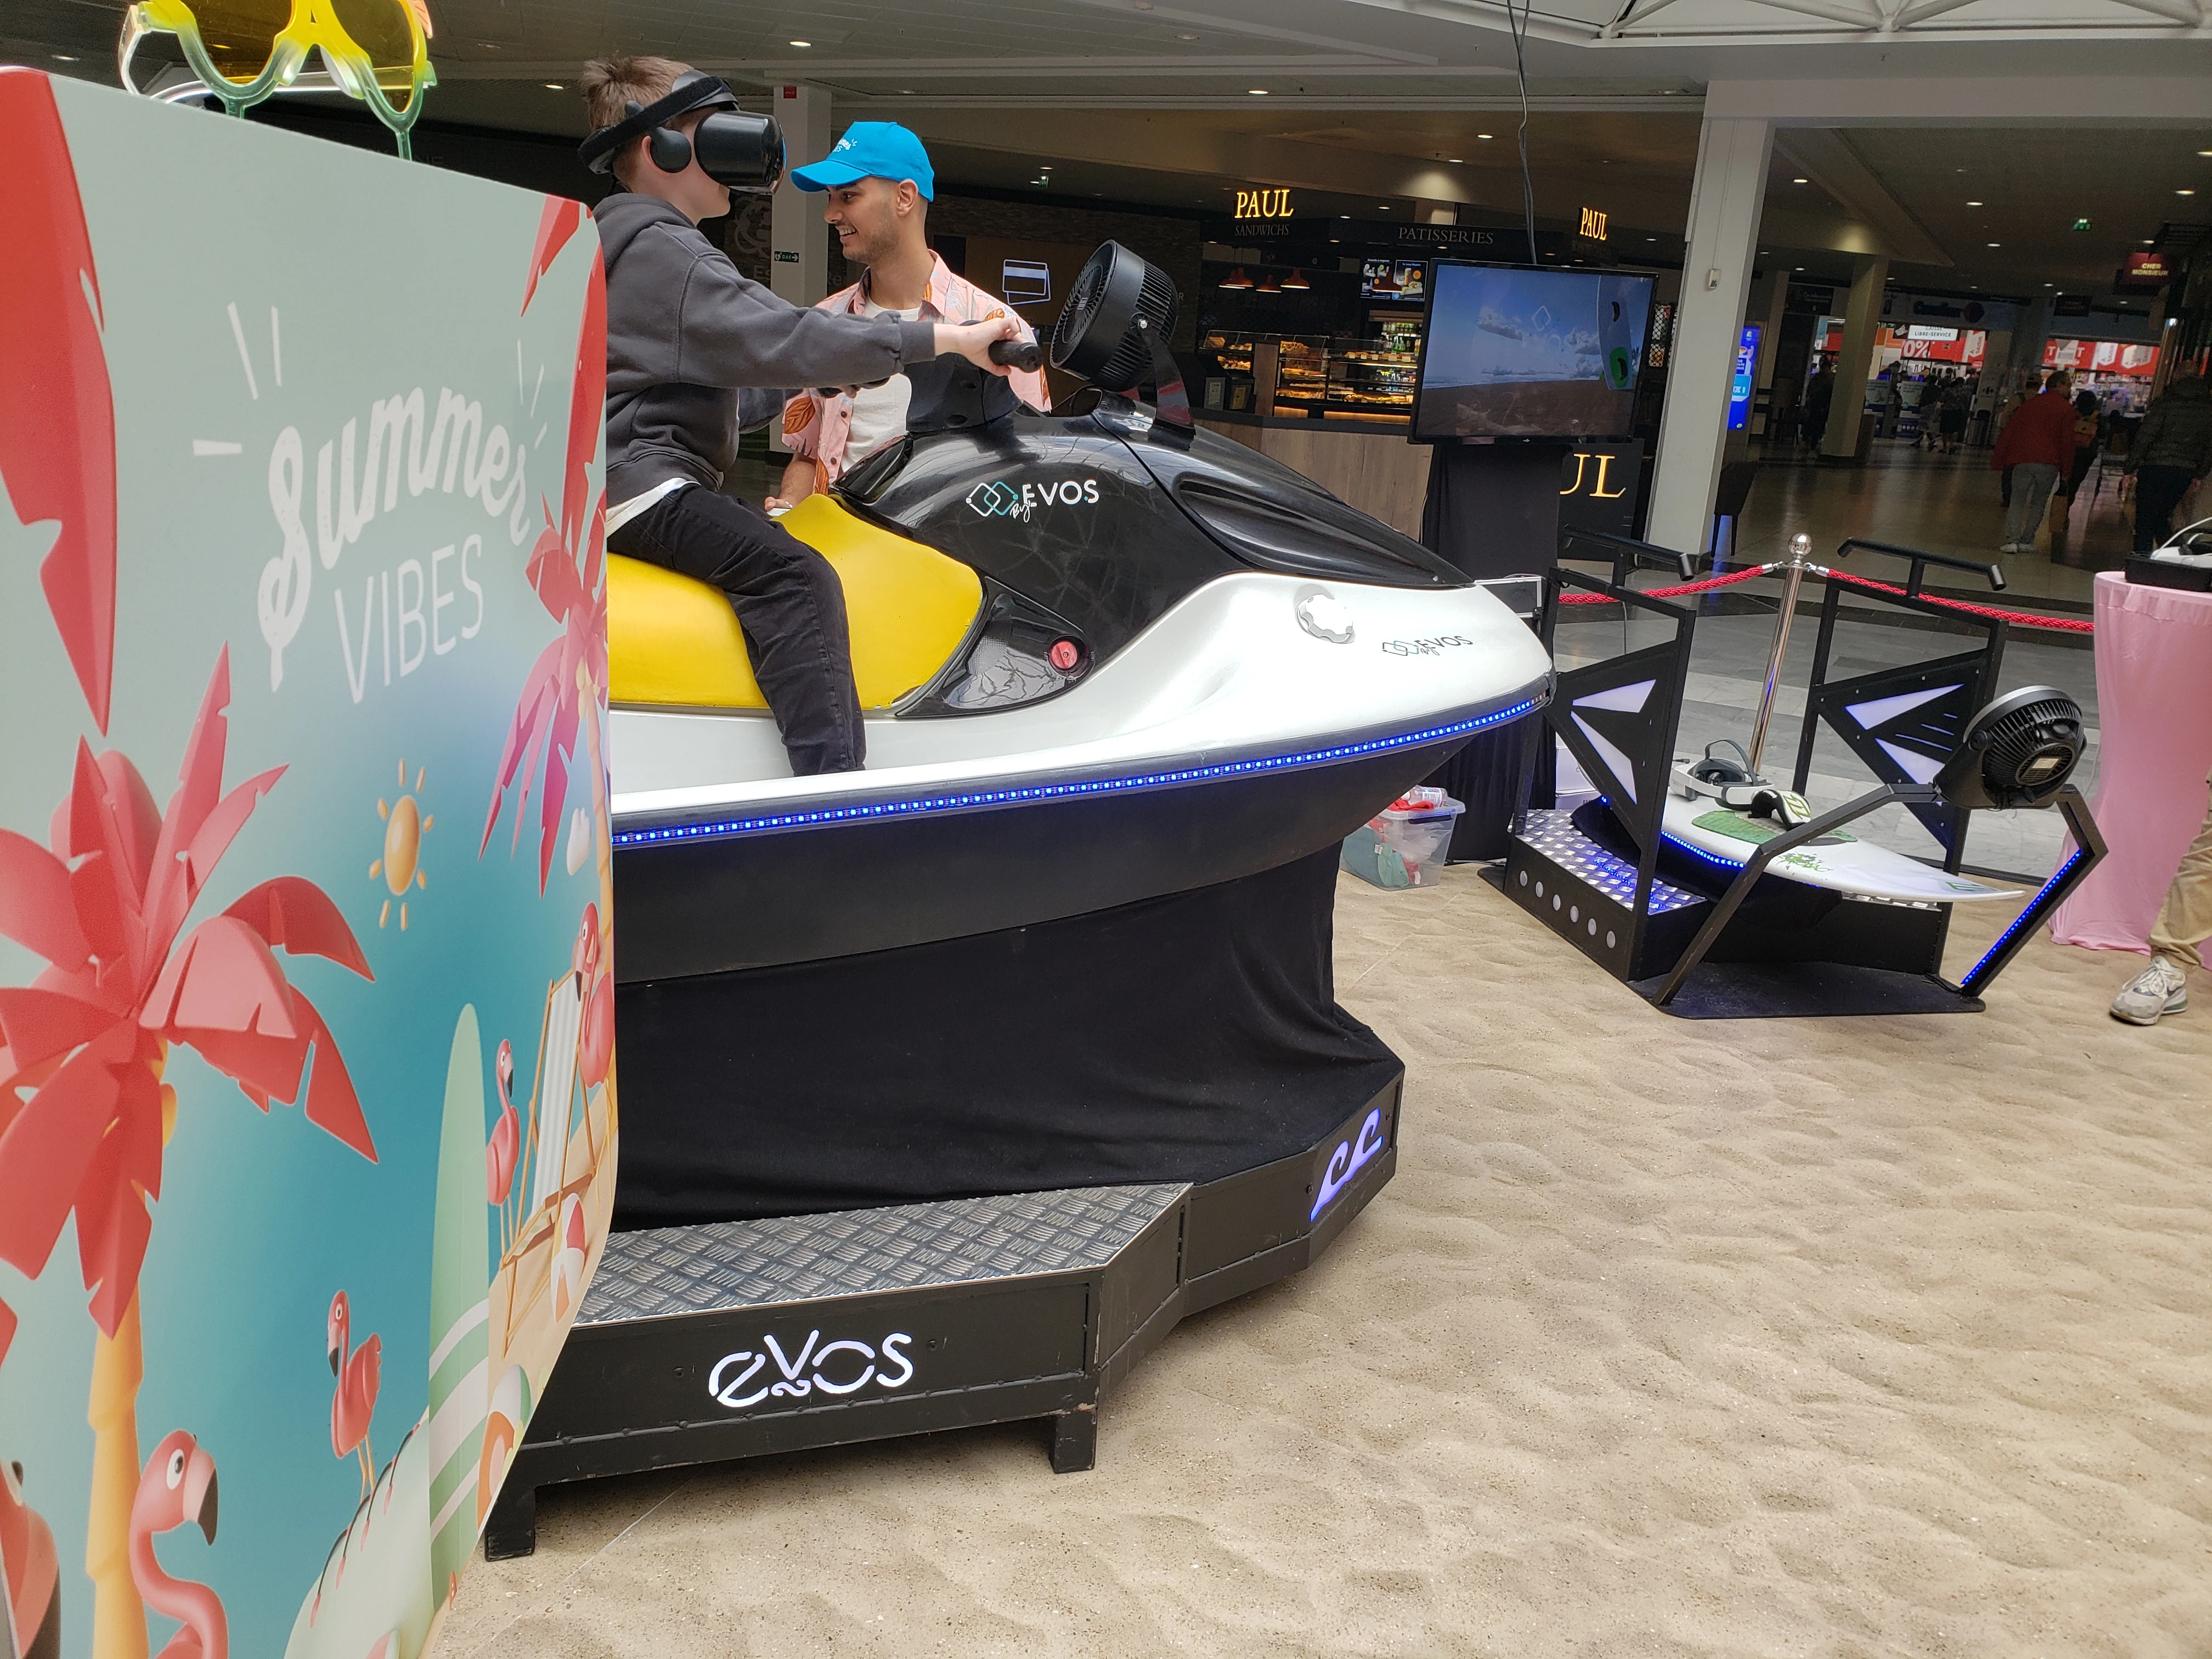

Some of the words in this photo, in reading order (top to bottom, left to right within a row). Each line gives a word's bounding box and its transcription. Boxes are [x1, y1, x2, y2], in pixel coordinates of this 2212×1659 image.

[1234, 189, 1294, 218] PAUL
[1235, 224, 1289, 236] SANDWICHS
[1399, 227, 1493, 244] PATISSERIES
[1580, 207, 1607, 241] PAUL
[1010, 500, 1031, 522] By
[1023, 479, 1099, 507] EVOS
[258, 387, 531, 692] Summer
[334, 534, 483, 704] VIBES
[1414, 636, 1473, 650] EVOS
